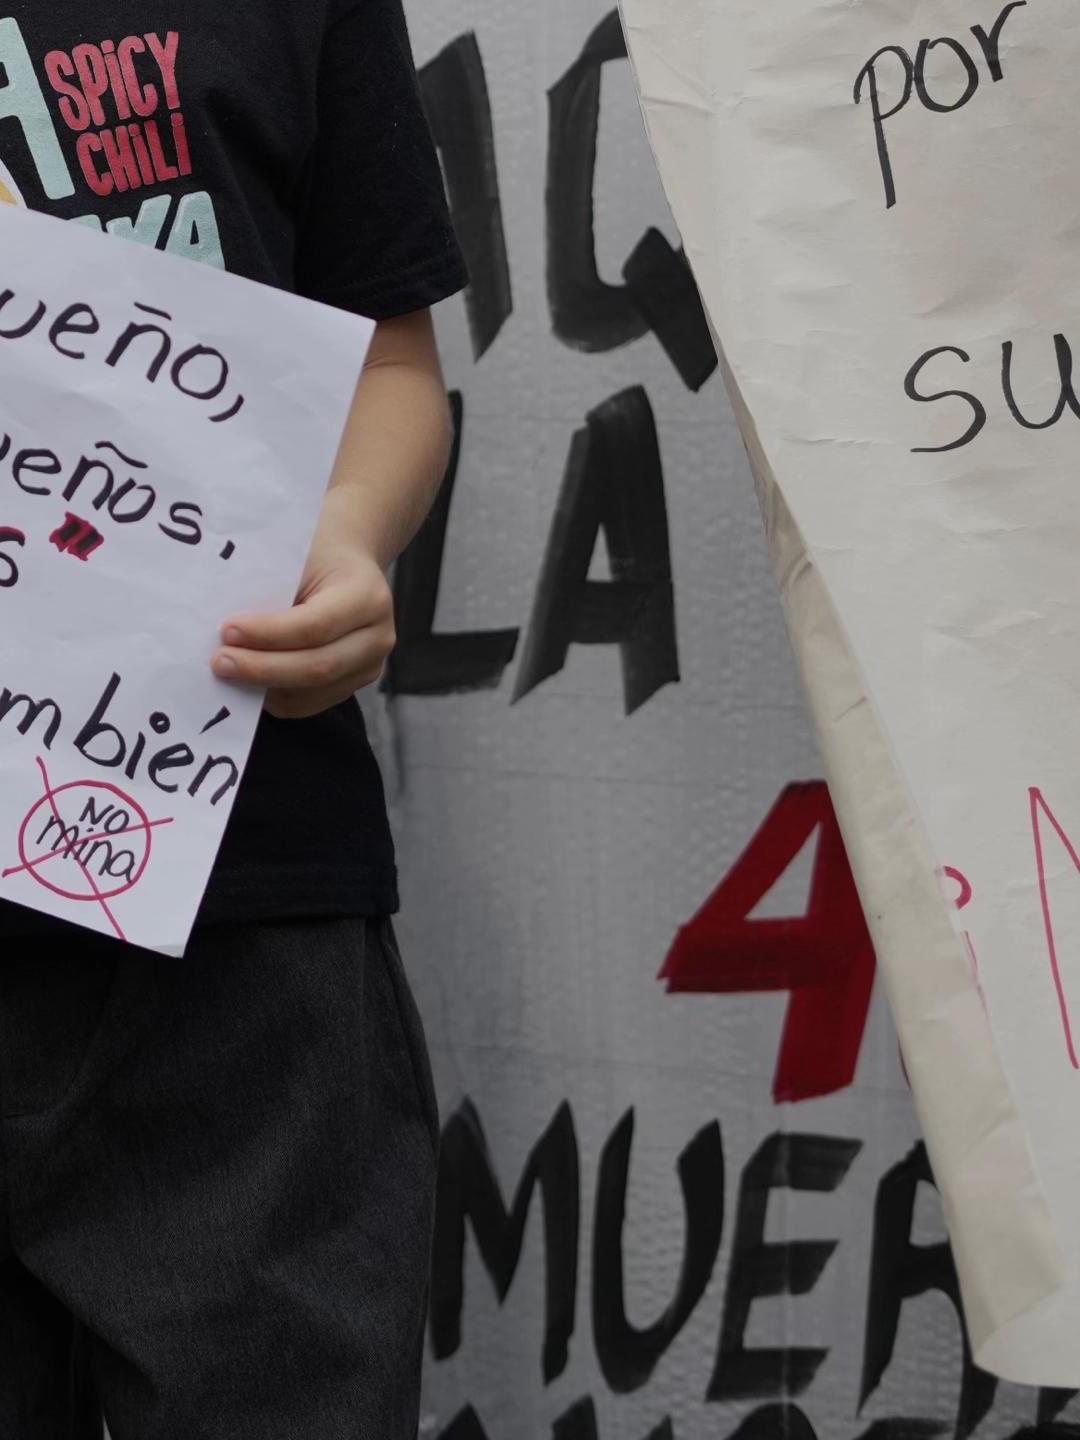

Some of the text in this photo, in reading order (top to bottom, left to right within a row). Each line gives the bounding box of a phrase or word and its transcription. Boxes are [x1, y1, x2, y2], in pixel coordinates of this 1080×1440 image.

[852, 0, 1027, 210] por
[379, 384, 681, 717] LA
[78, 794, 132, 837] NO
[657, 778, 908, 1105] 4
[428, 1095, 1080, 1440] MUER
